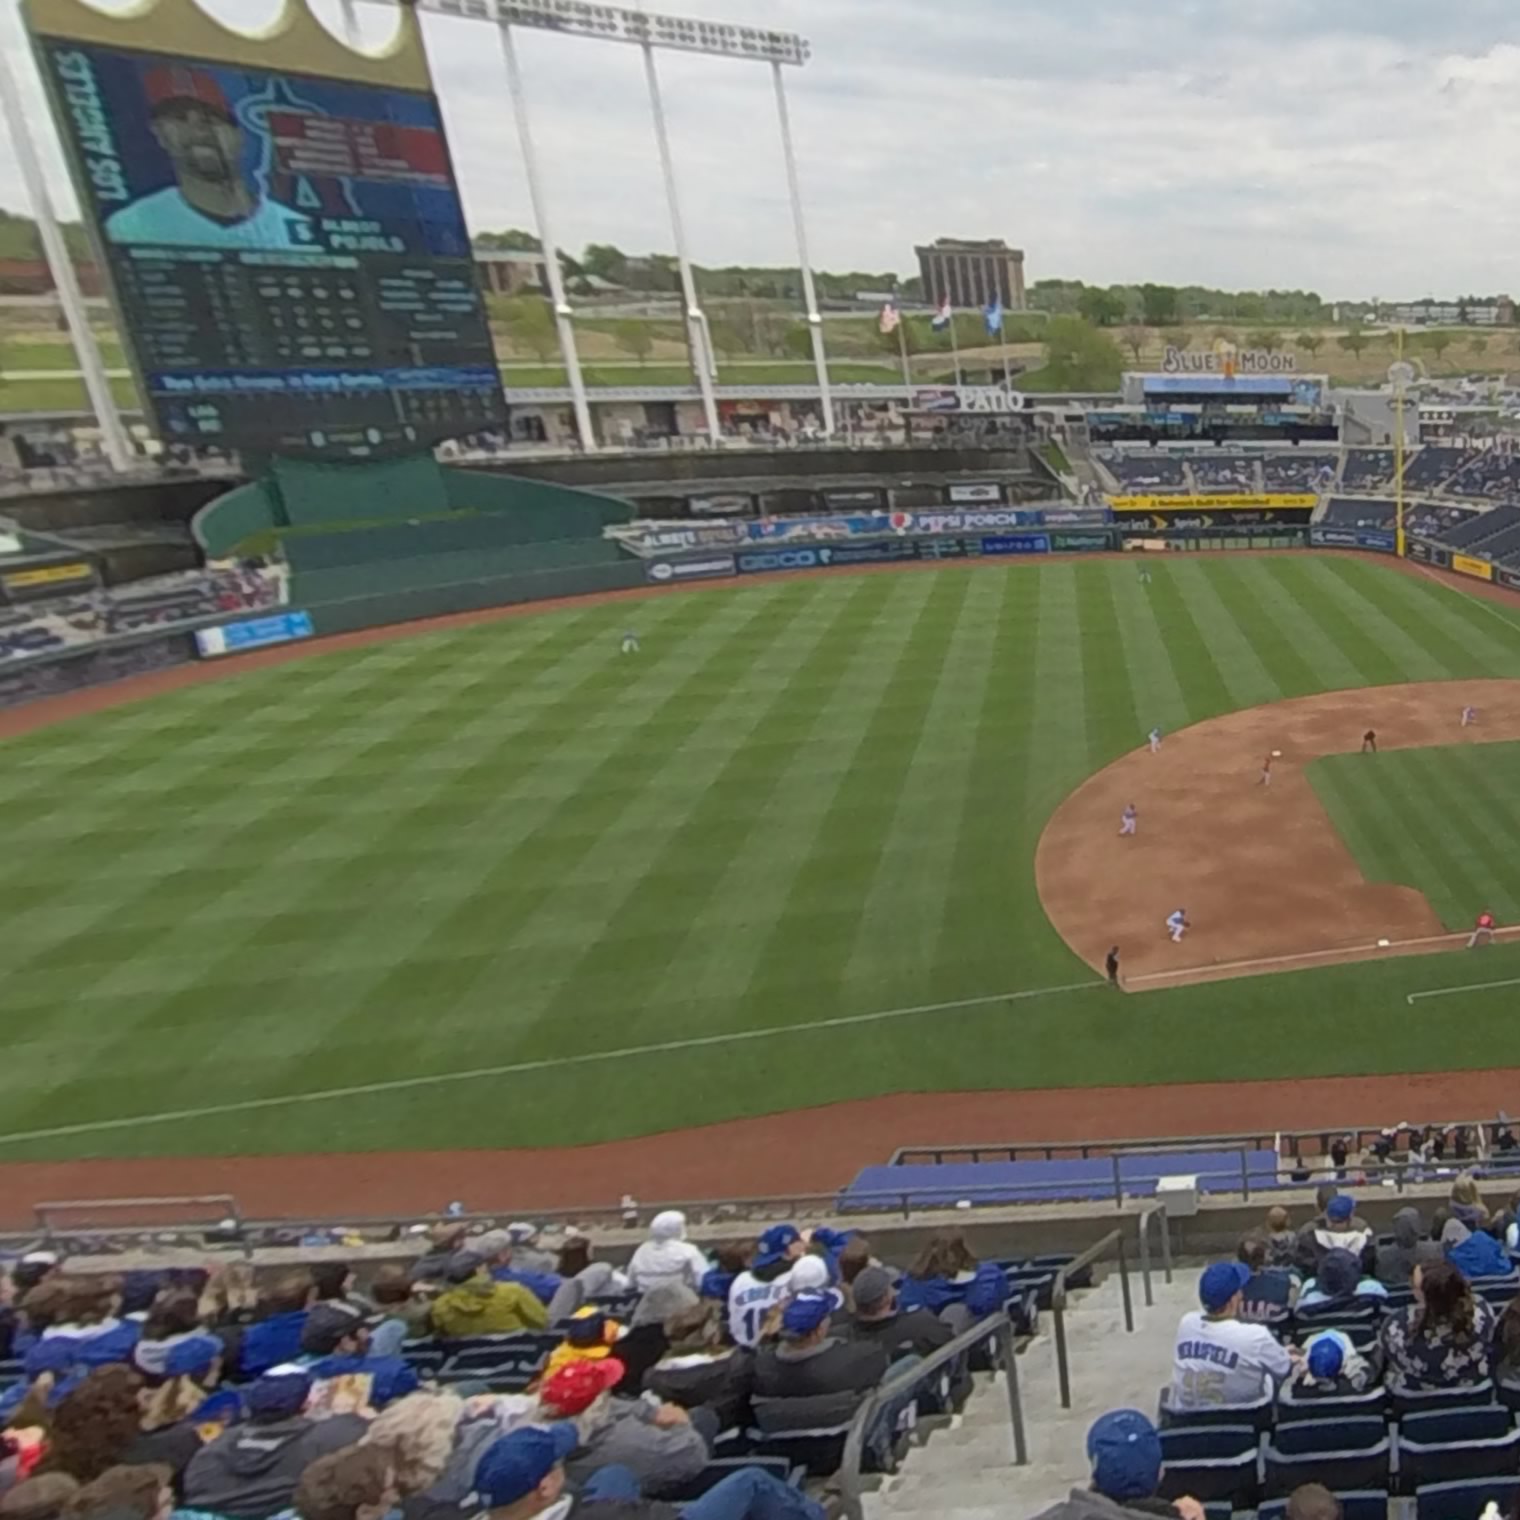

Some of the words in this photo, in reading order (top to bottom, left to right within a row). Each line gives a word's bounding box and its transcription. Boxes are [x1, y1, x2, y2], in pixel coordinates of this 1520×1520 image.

[55, 51, 118, 156] ANGELES
[86, 158, 129, 200] LOS
[329, 233, 406, 253] PUJOLS
[1162, 345, 1214, 374] BLUE
[1240, 351, 1296, 372] MOON
[960, 388, 1024, 412] PATIO
[919, 514, 961, 527] PEPSI
[965, 513, 1017, 528] PORCH
[738, 550, 816, 571] GEICO
